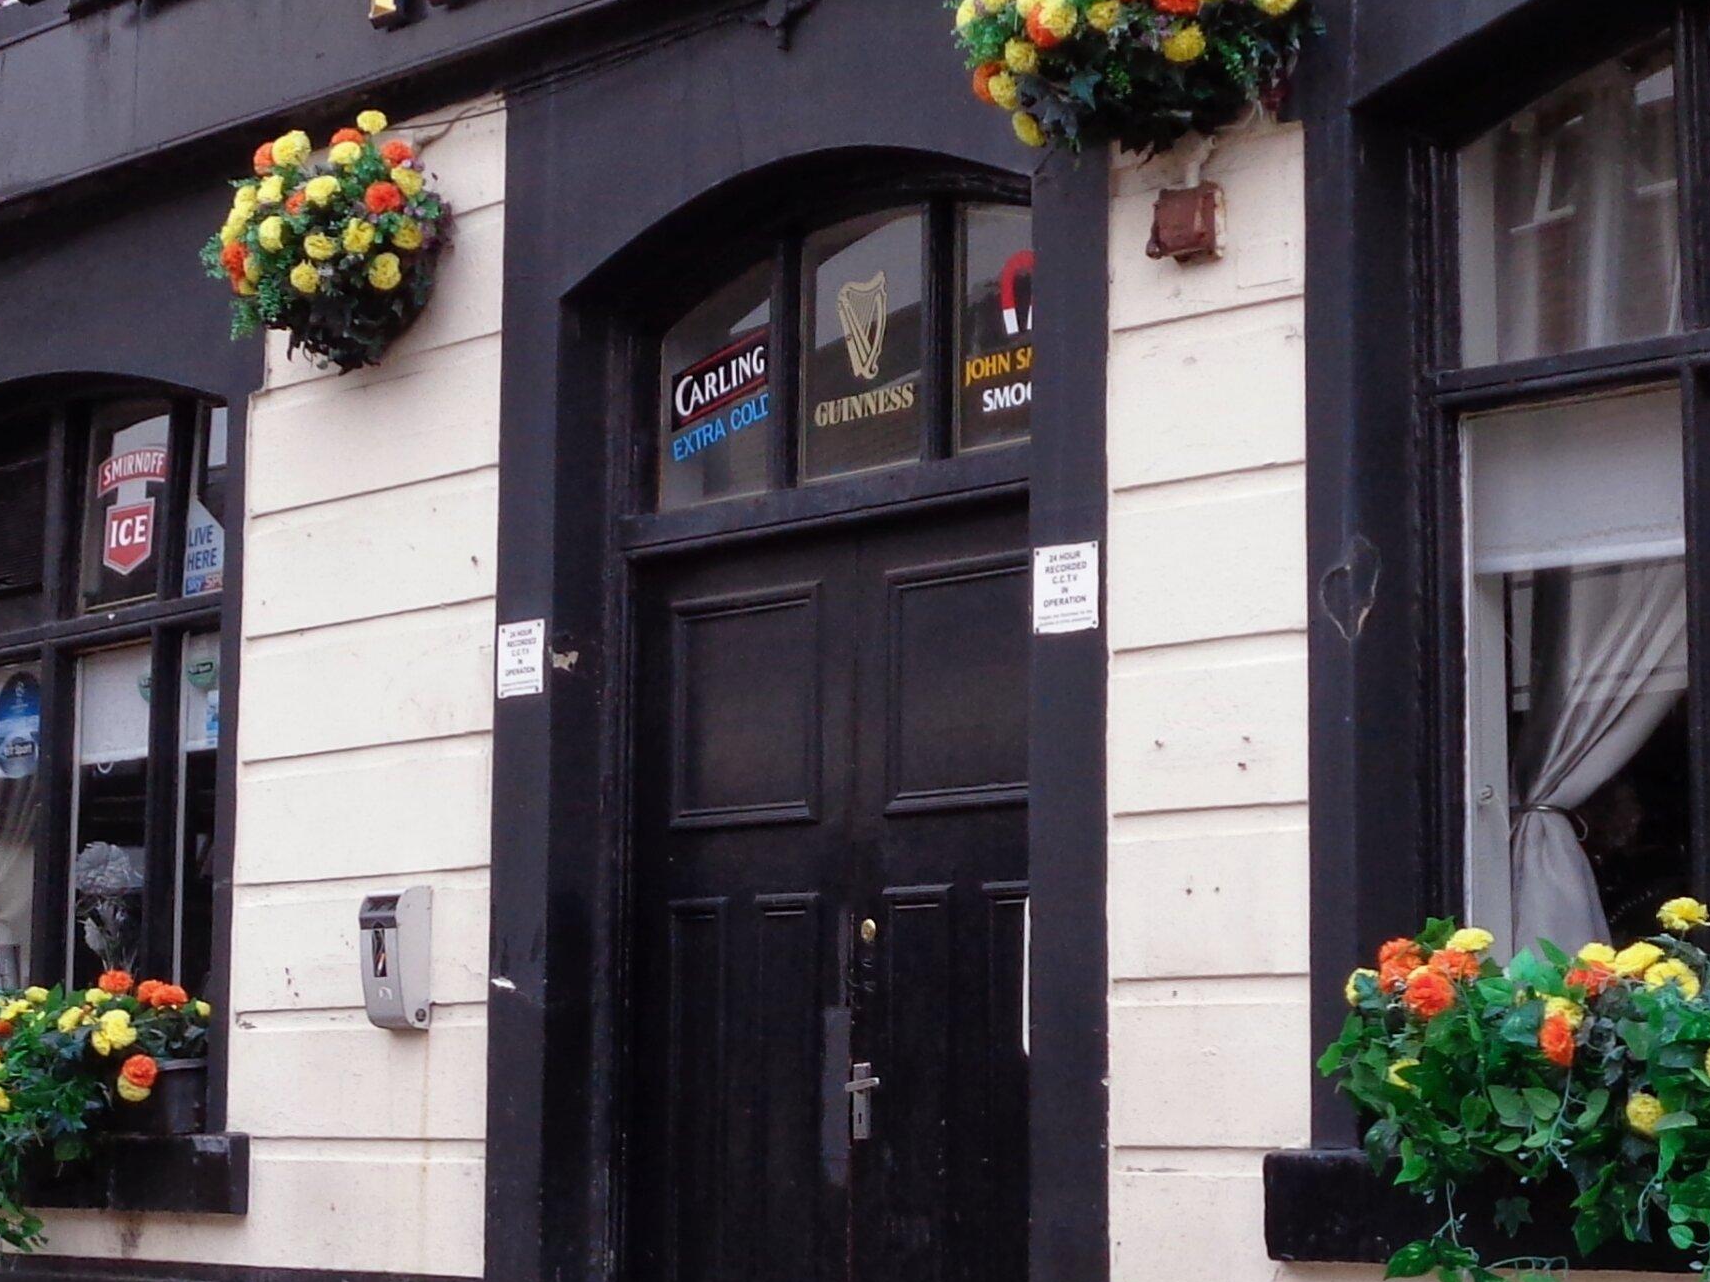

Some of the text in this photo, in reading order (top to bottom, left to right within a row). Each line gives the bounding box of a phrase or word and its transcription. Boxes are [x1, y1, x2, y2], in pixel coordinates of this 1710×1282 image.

[675, 346, 765, 416] CARLING
[966, 346, 1032, 386] JOHN S
[814, 383, 915, 427] GUINNESS
[983, 382, 1032, 412] SMO
[673, 418, 727, 461] EXTRA
[102, 452, 167, 486] SMIRNOFF
[109, 515, 148, 549] ICE
[189, 524, 213, 547] LIVE
[188, 548, 217, 571] HERE
[1043, 595, 1087, 608] OPERATION
